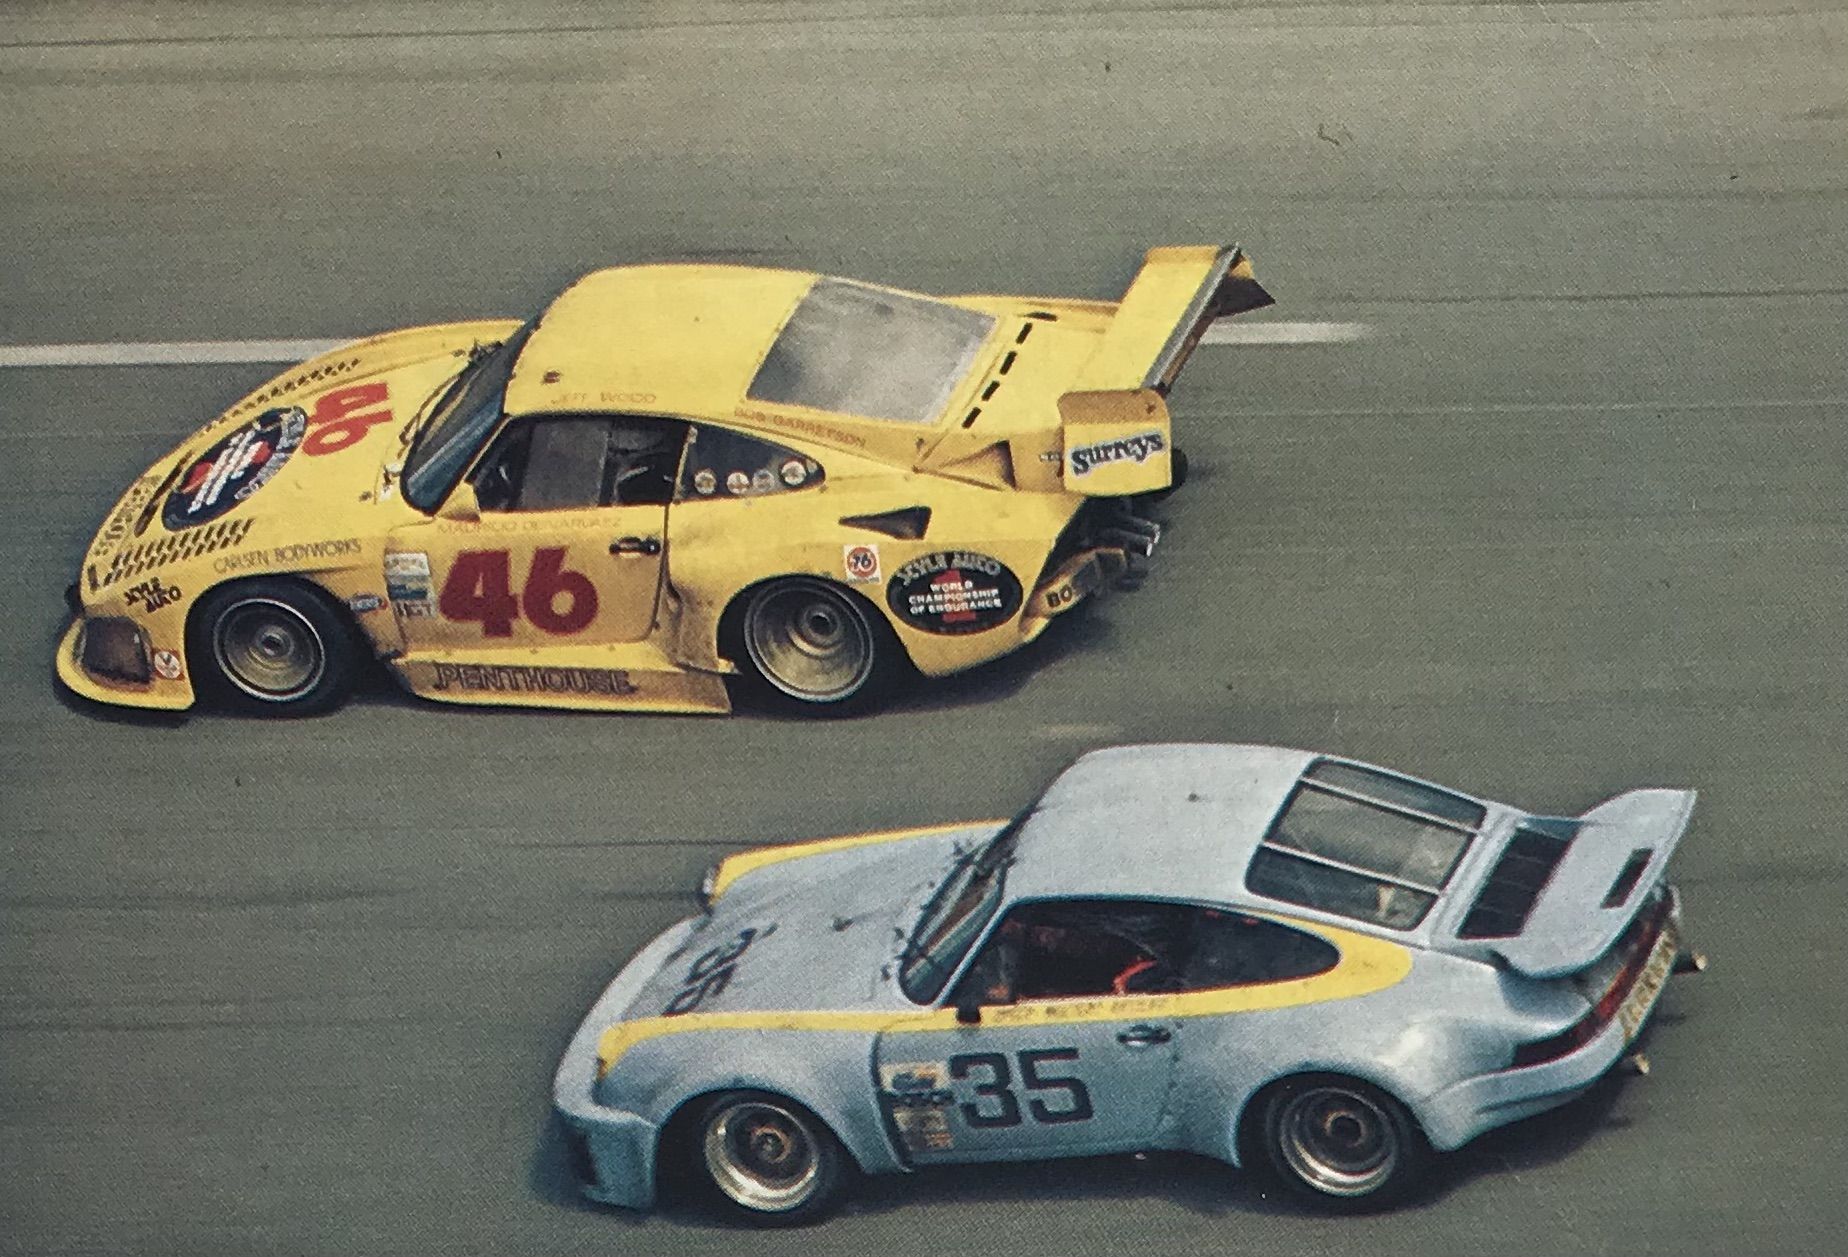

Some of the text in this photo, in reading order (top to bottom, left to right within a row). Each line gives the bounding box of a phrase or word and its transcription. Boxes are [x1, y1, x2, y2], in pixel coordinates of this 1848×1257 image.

[852, 552, 872, 570] 76
[438, 546, 599, 638] 46
[929, 580, 973, 593] WORLD
[908, 588, 999, 604] CHAMPIONSHIP
[909, 598, 1002, 615] OF ENDURANCE
[434, 662, 639, 694] PENTHOUSE
[950, 1047, 1094, 1128] 35
